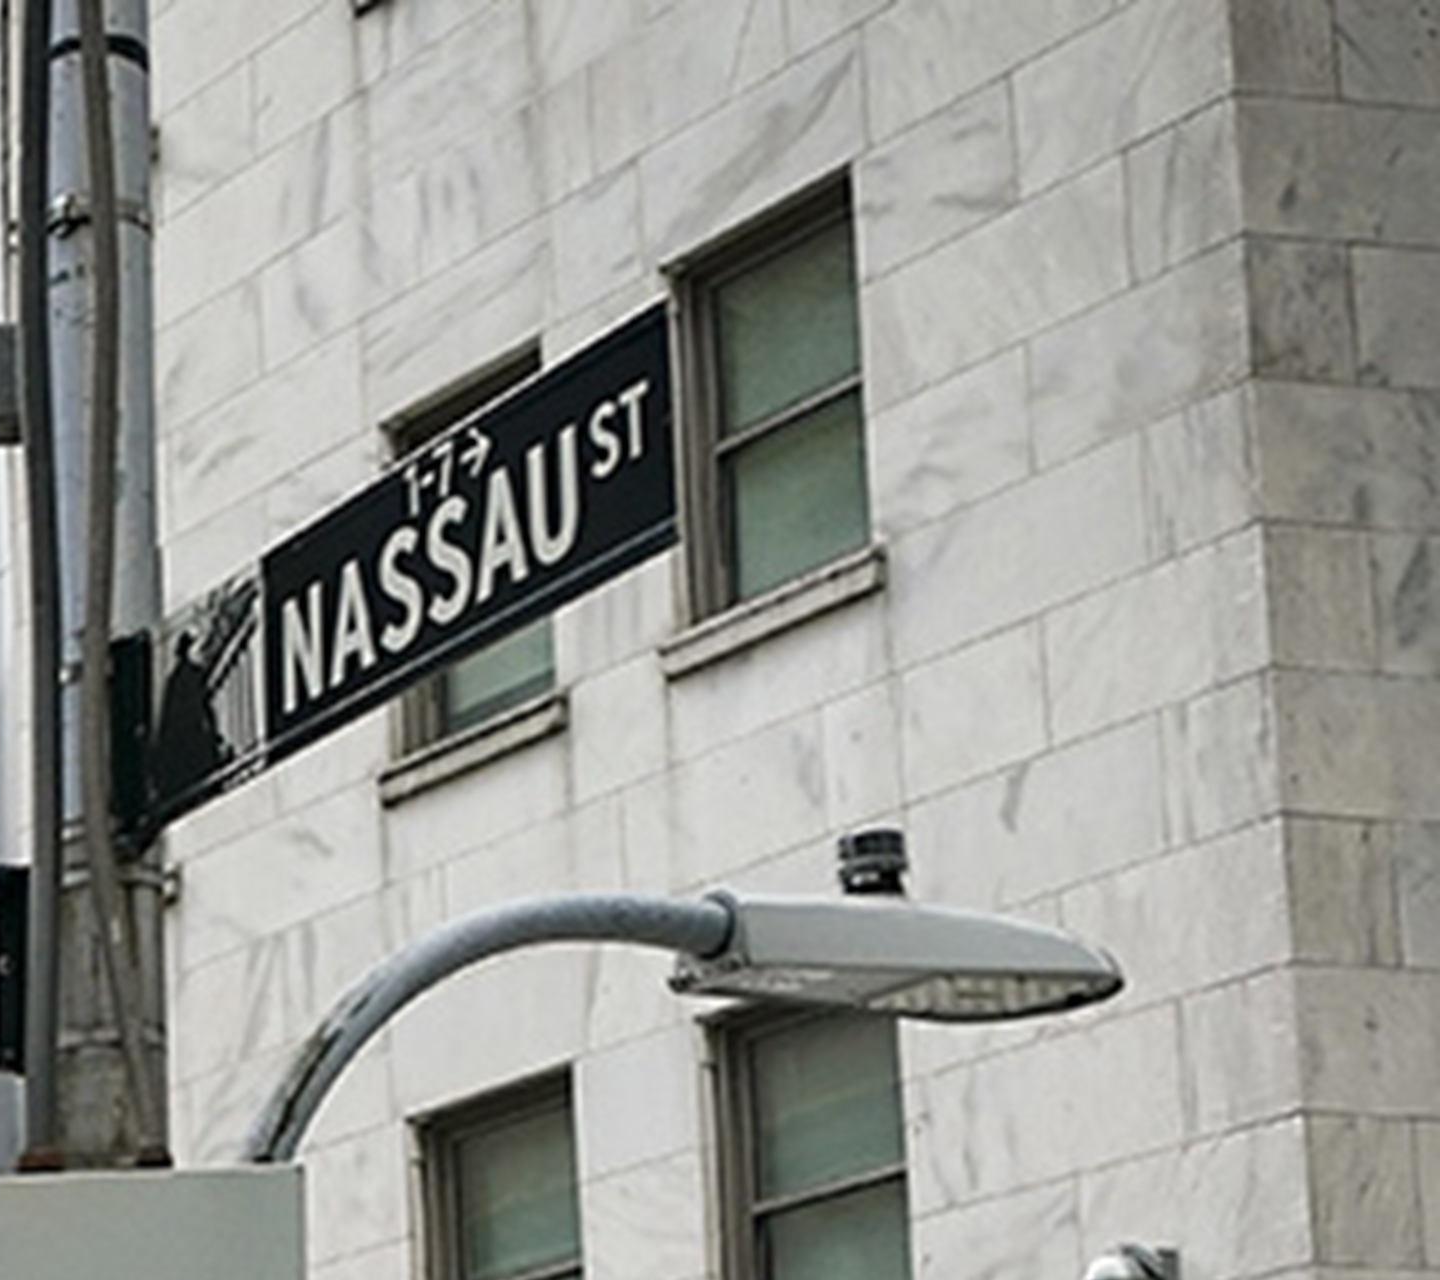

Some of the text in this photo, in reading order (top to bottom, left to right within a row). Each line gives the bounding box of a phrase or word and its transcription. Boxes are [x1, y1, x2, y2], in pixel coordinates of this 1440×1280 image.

[282, 380, 650, 715] NASSAU ST
[404, 440, 454, 516] 1-7
